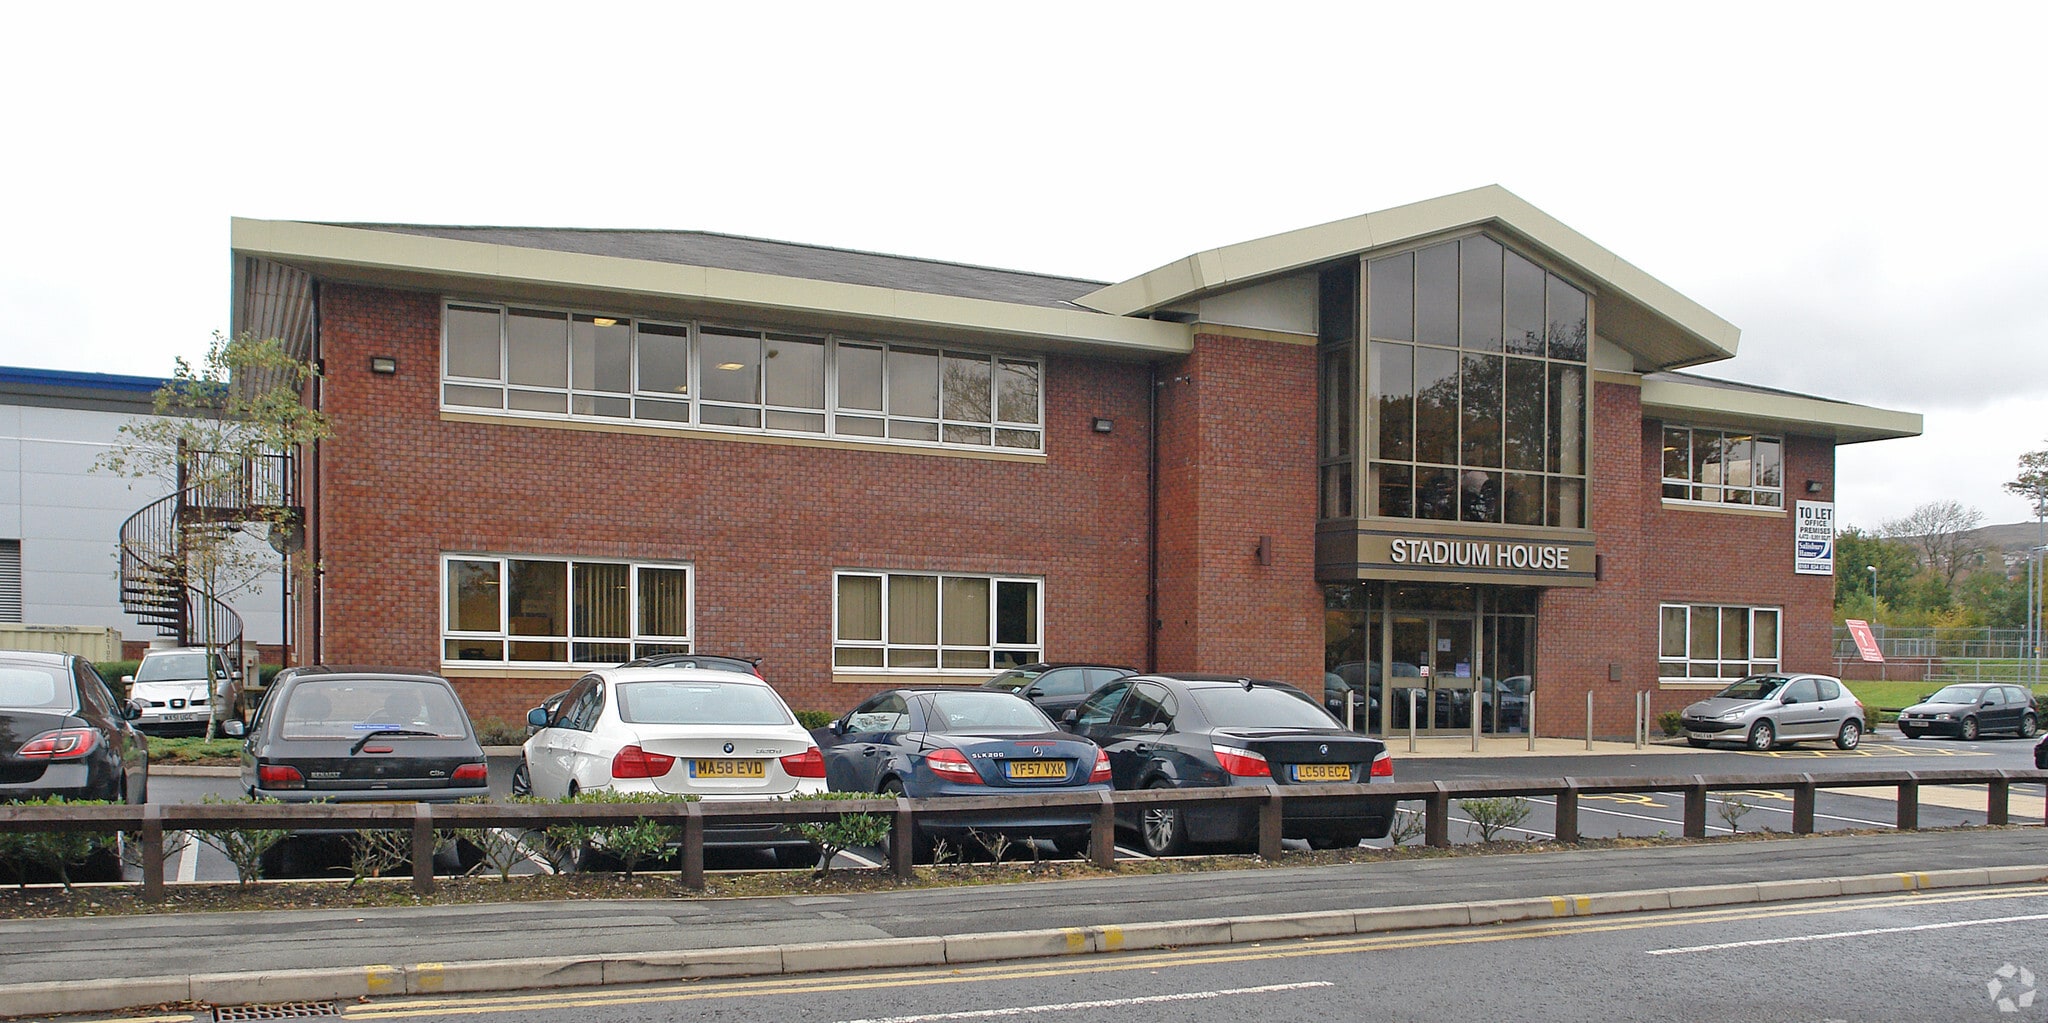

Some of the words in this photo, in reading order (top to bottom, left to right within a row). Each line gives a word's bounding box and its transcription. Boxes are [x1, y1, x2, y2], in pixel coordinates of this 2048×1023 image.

[1799, 507, 1812, 519] TO
[1815, 508, 1832, 520] LET
[1804, 519, 1827, 527] OFFICE
[1391, 538, 1490, 566] STADIUM
[1496, 544, 1570, 569] HOUSE
[698, 761, 734, 774] MA58
[737, 762, 763, 774] EVD
[1013, 763, 1041, 775] YF57
[1044, 763, 1065, 775] VXK
[1300, 766, 1326, 777] LC58
[1328, 766, 1348, 777] ECZ
